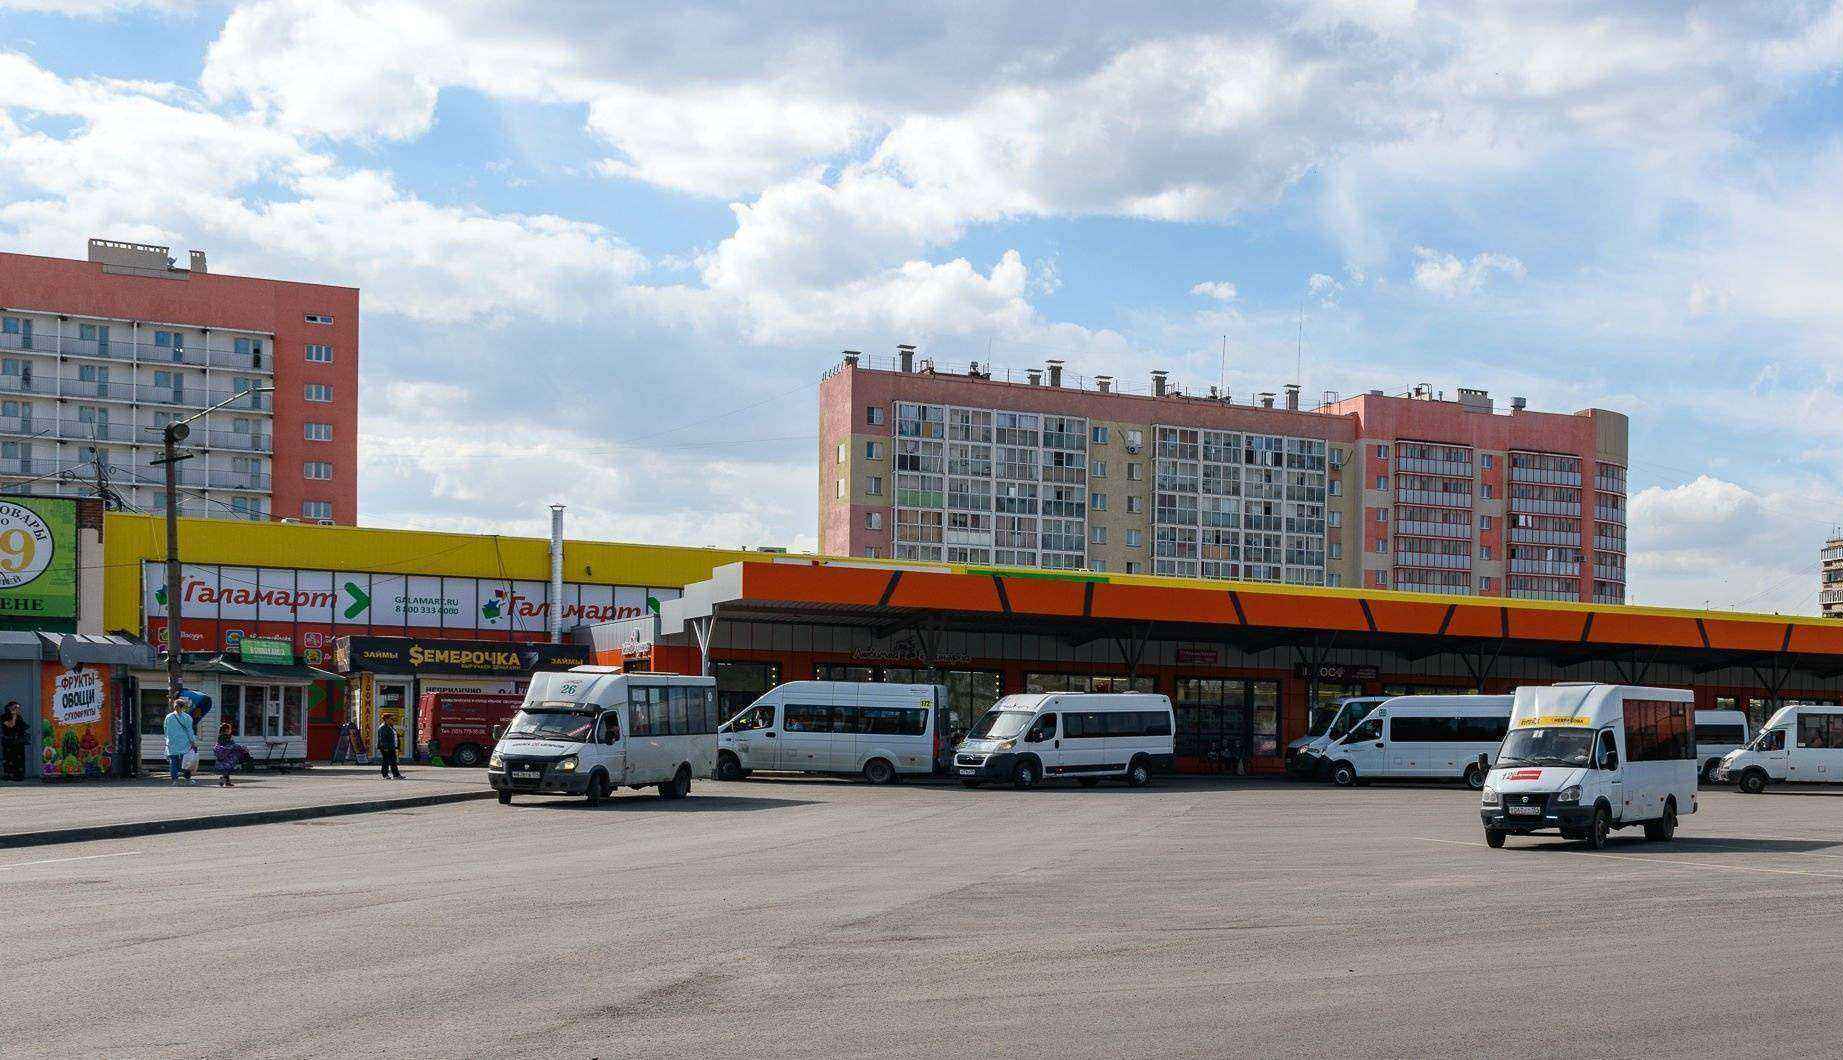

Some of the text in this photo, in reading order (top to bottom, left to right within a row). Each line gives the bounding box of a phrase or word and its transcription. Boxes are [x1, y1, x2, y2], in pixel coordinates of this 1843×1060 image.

[184, 580, 338, 615] Галамарт
[507, 595, 641, 624] Галмарт
[363, 650, 399, 660] ЗАЙМЫ
[61, 672, 95, 690] ФРУКТЫ
[560, 684, 577, 695] 26
[62, 689, 95, 708] ОВОЩИ
